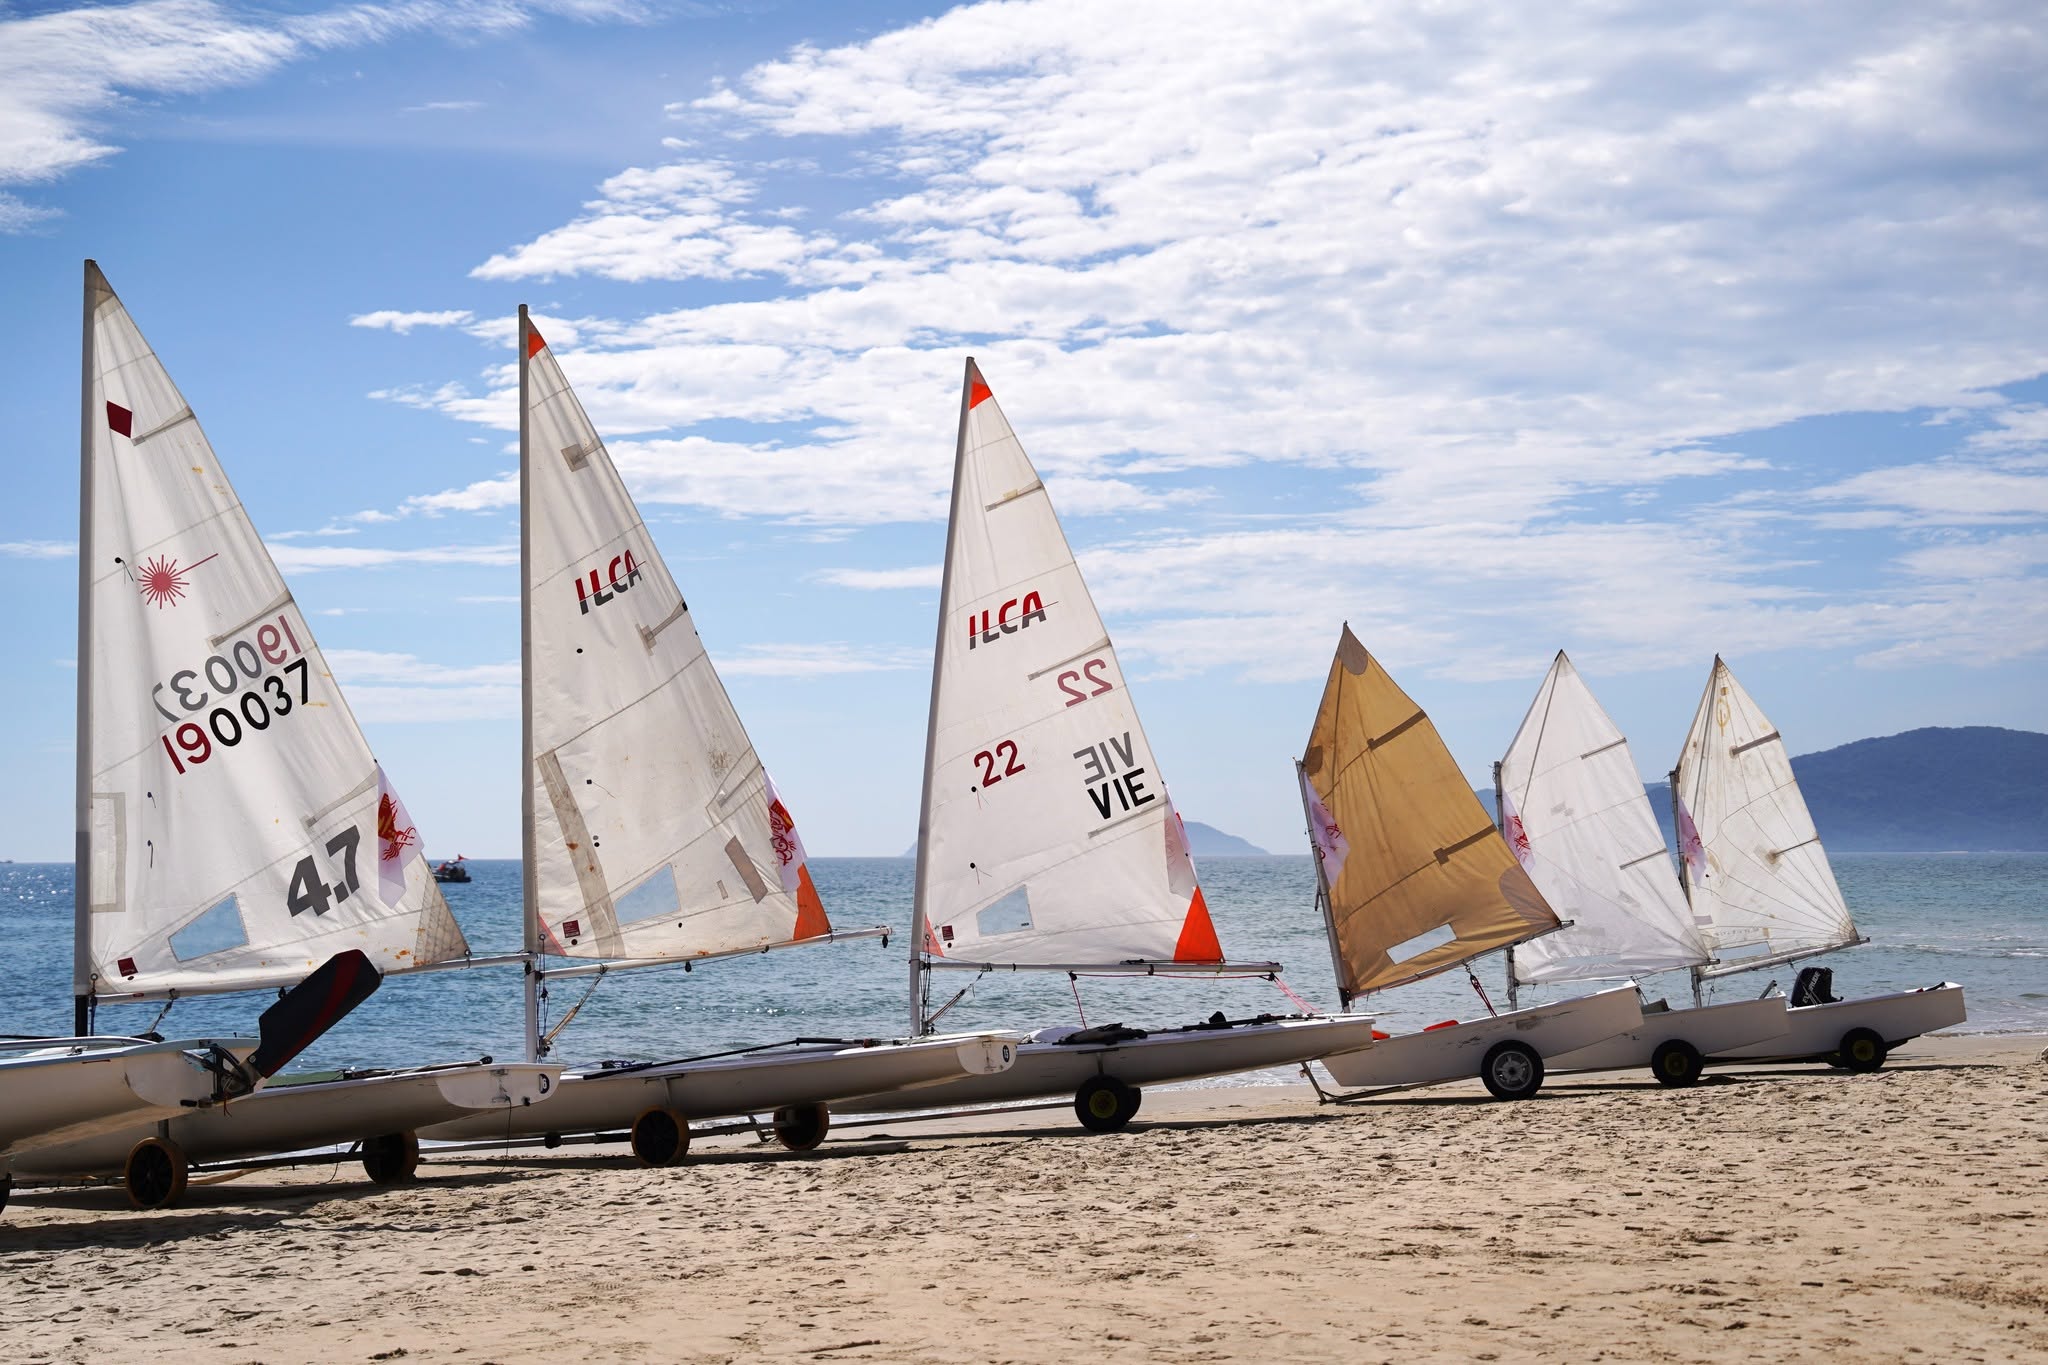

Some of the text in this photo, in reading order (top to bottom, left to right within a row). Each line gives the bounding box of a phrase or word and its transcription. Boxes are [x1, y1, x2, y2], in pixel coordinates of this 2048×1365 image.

[575, 549, 643, 615] ILCA
[968, 590, 1047, 650] ILCA
[161, 656, 309, 775] 190037
[973, 739, 1026, 788] 22
[1087, 767, 1156, 820] VIE
[286, 824, 361, 918] 4.7
